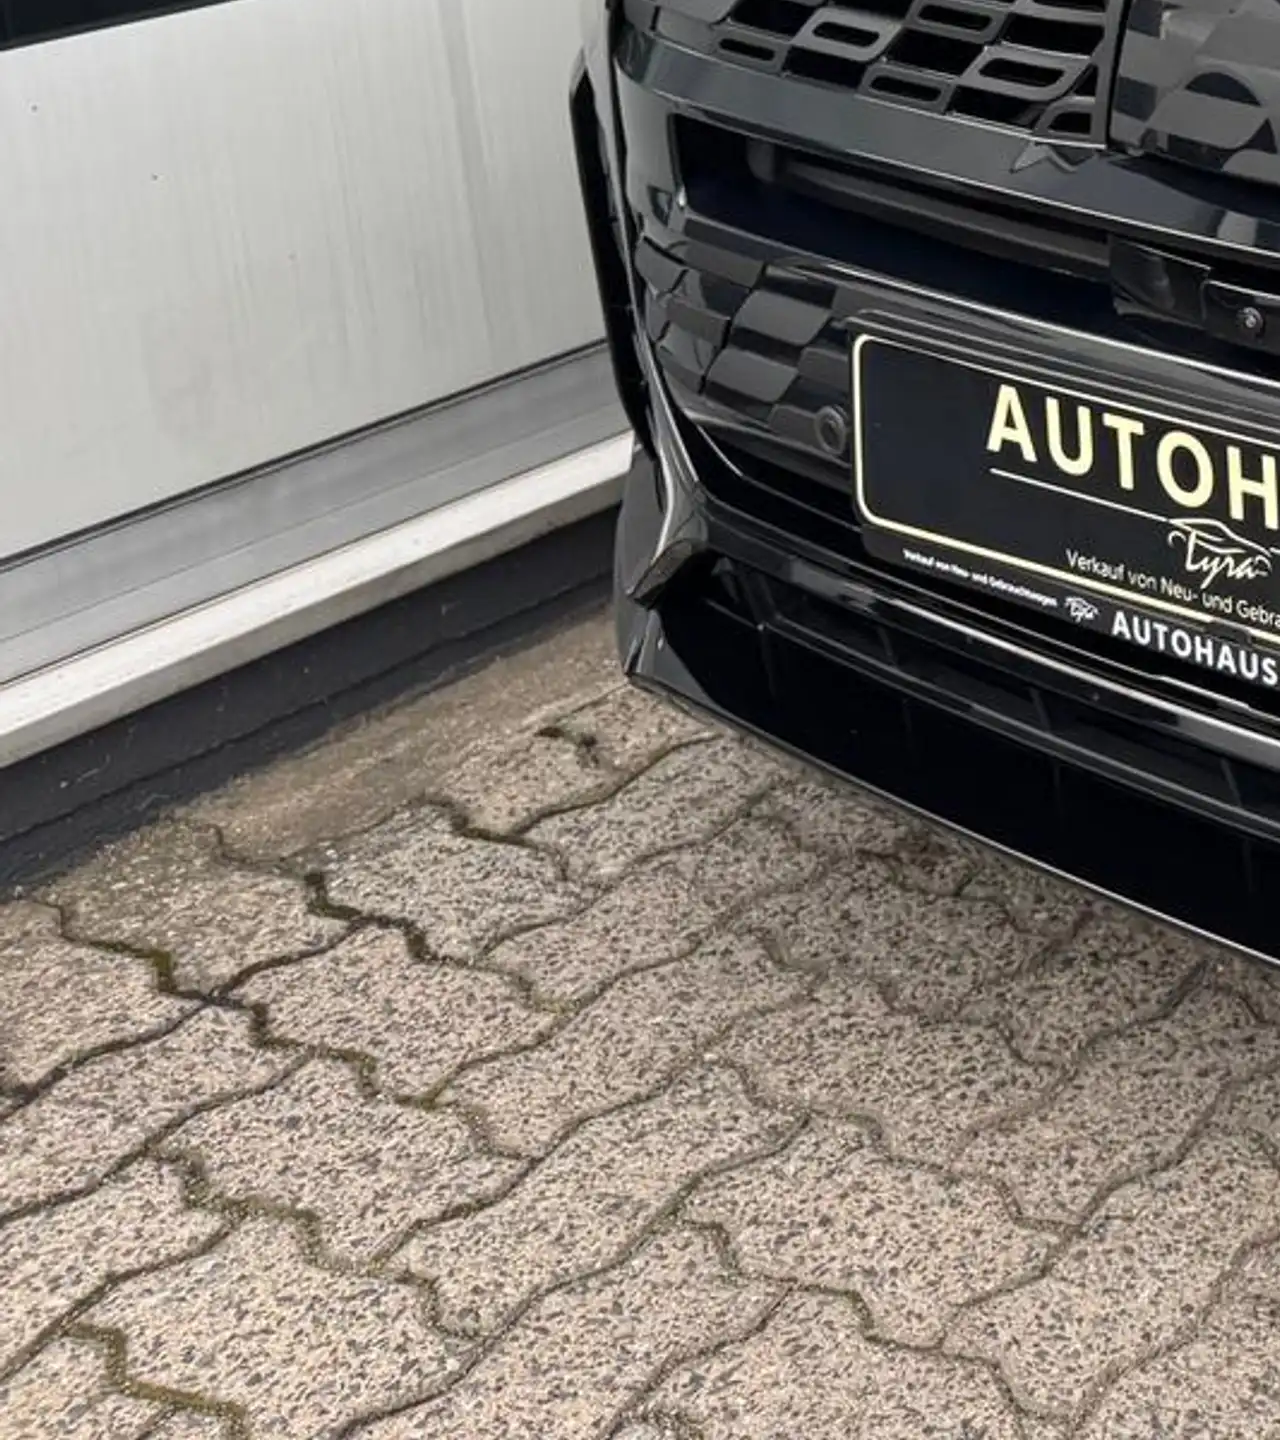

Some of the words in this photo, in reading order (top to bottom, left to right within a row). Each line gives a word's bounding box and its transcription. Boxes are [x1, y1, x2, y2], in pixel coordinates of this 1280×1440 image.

[1065, 548, 1125, 578] Verkauf
[1127, 569, 1157, 592] von
[1160, 576, 1199, 602] Neu-
[1202, 591, 1233, 615] und
[1168, 529, 1266, 589] Lyra
[1110, 611, 1278, 686] AUTOHAUS
